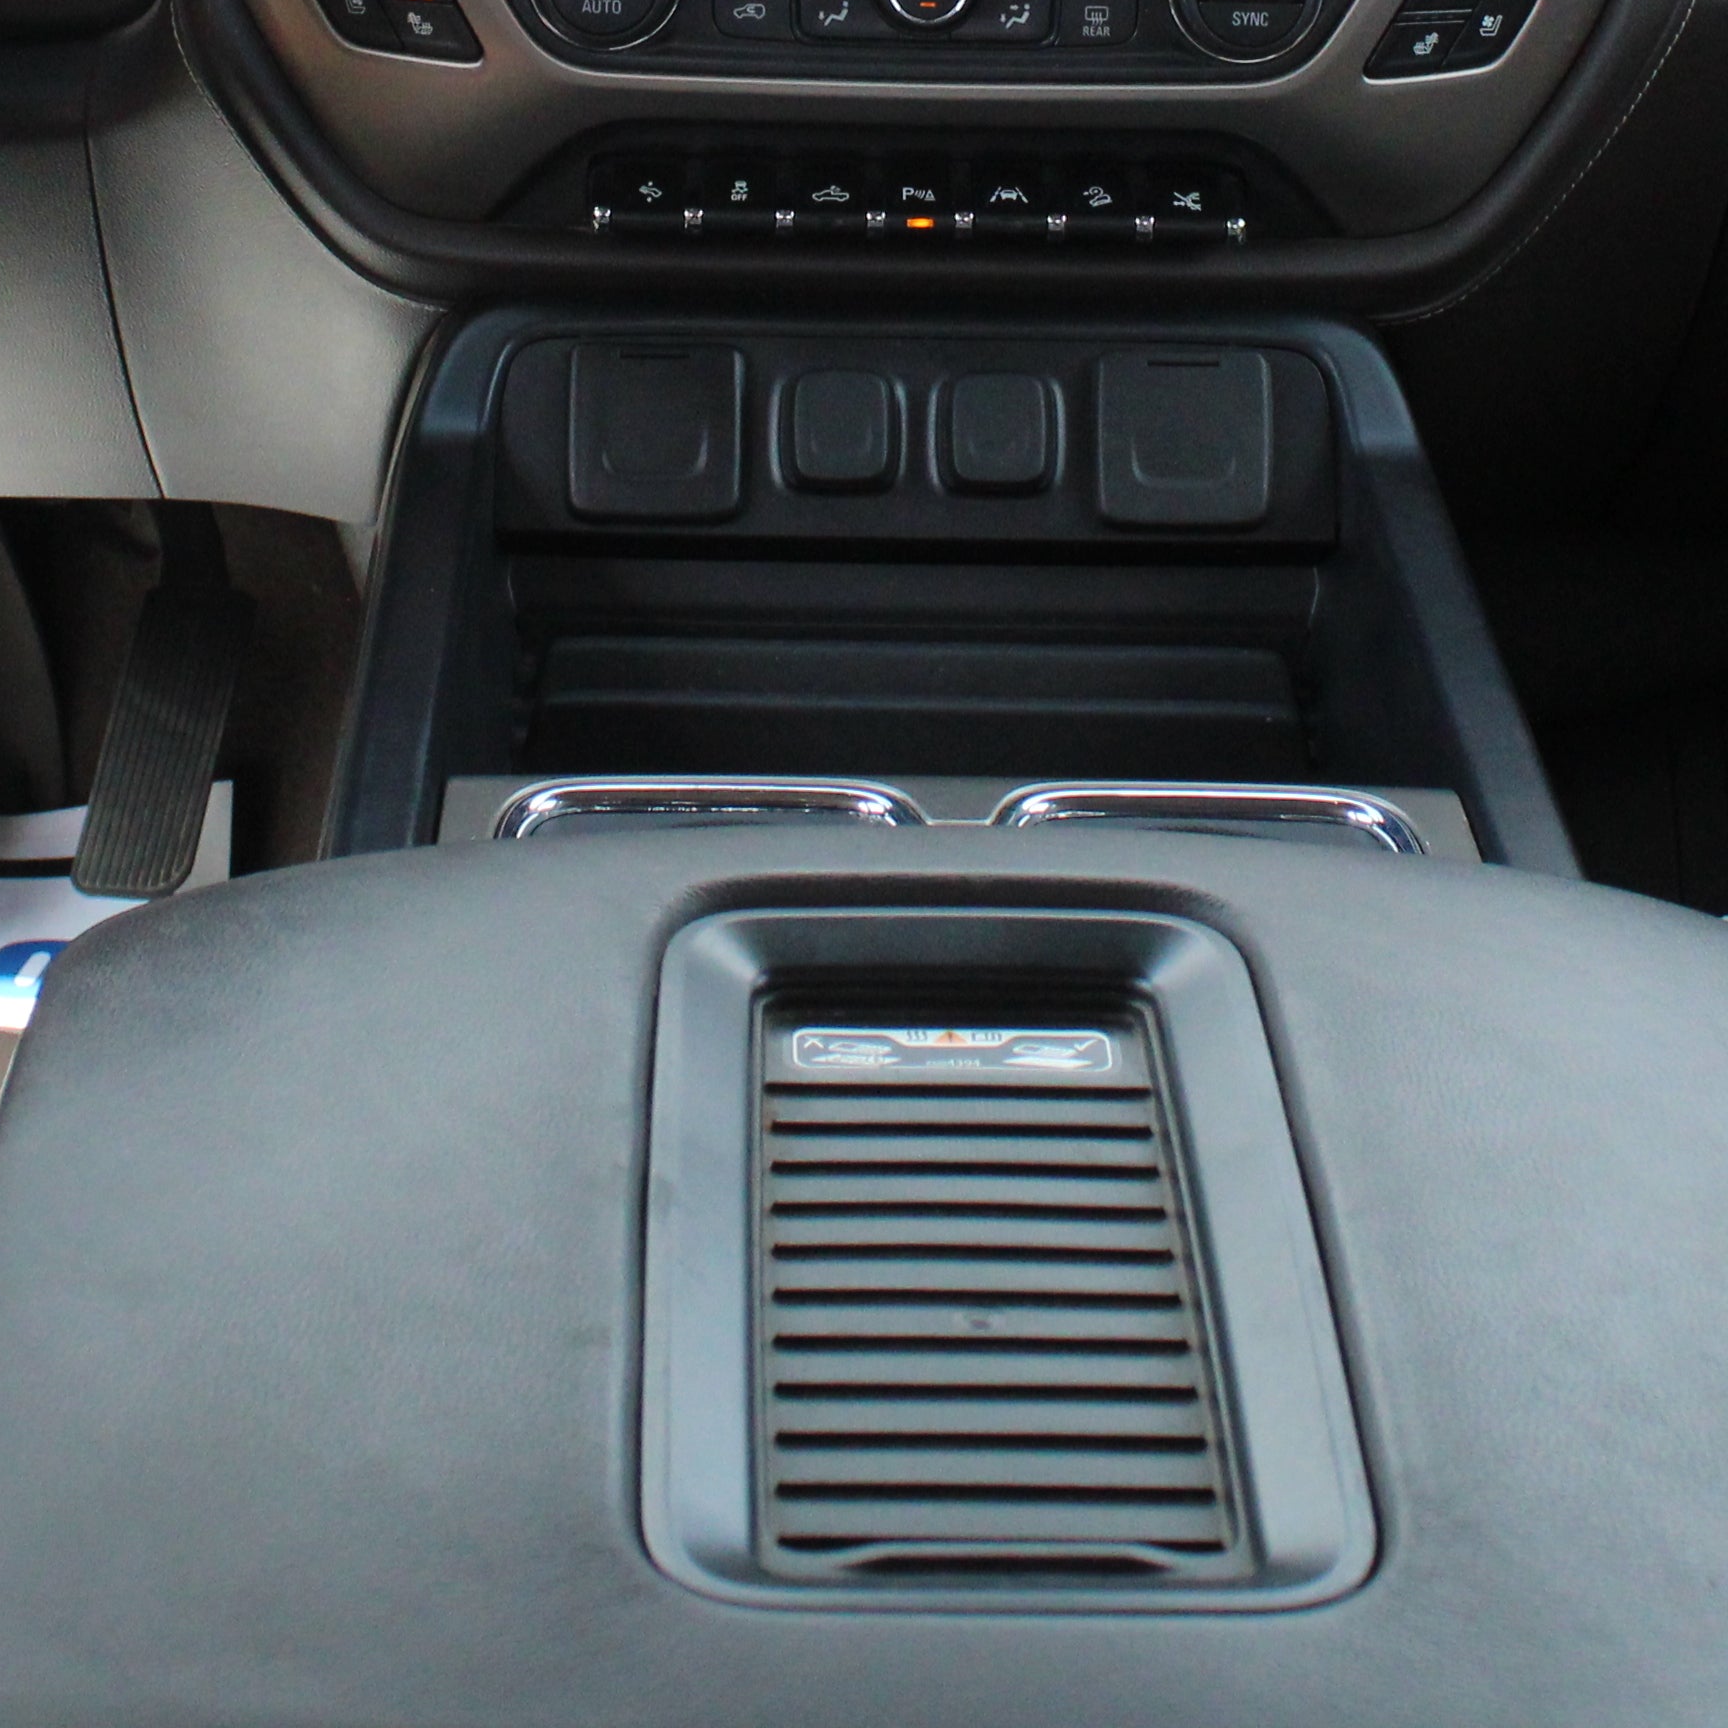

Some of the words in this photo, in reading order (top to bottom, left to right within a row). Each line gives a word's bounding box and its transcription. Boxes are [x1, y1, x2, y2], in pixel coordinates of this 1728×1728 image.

[582, 0, 622, 15] AUTO
[1232, 11, 1270, 27] SYNC
[1082, 26, 1111, 37] REAR
[731, 193, 748, 201] OFF
